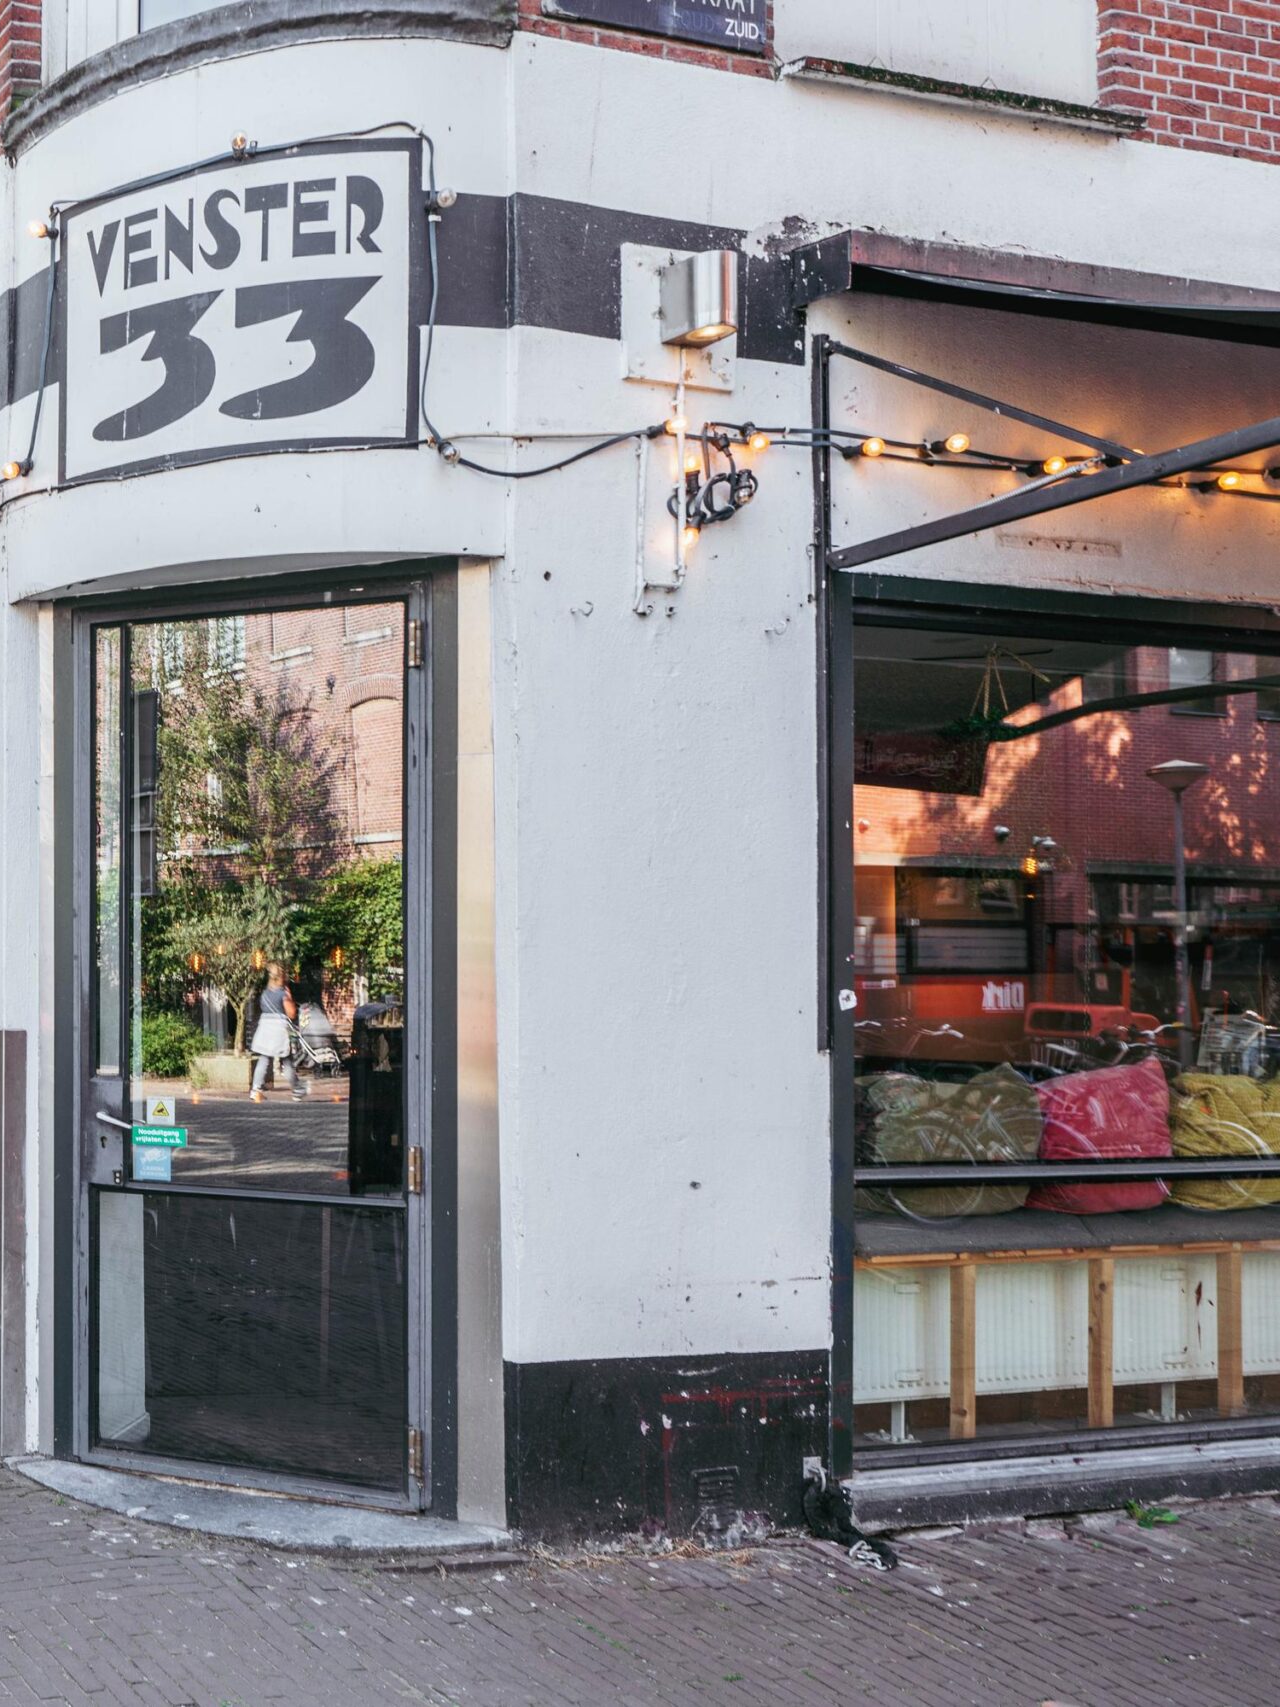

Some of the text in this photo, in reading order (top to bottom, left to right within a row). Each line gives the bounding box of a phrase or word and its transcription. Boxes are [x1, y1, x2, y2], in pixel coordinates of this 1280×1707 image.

[725, 18, 760, 40] ZUID
[86, 175, 385, 298] VENSTER
[92, 275, 383, 442] 33
[138, 1128, 180, 1137] Nooduitgang
